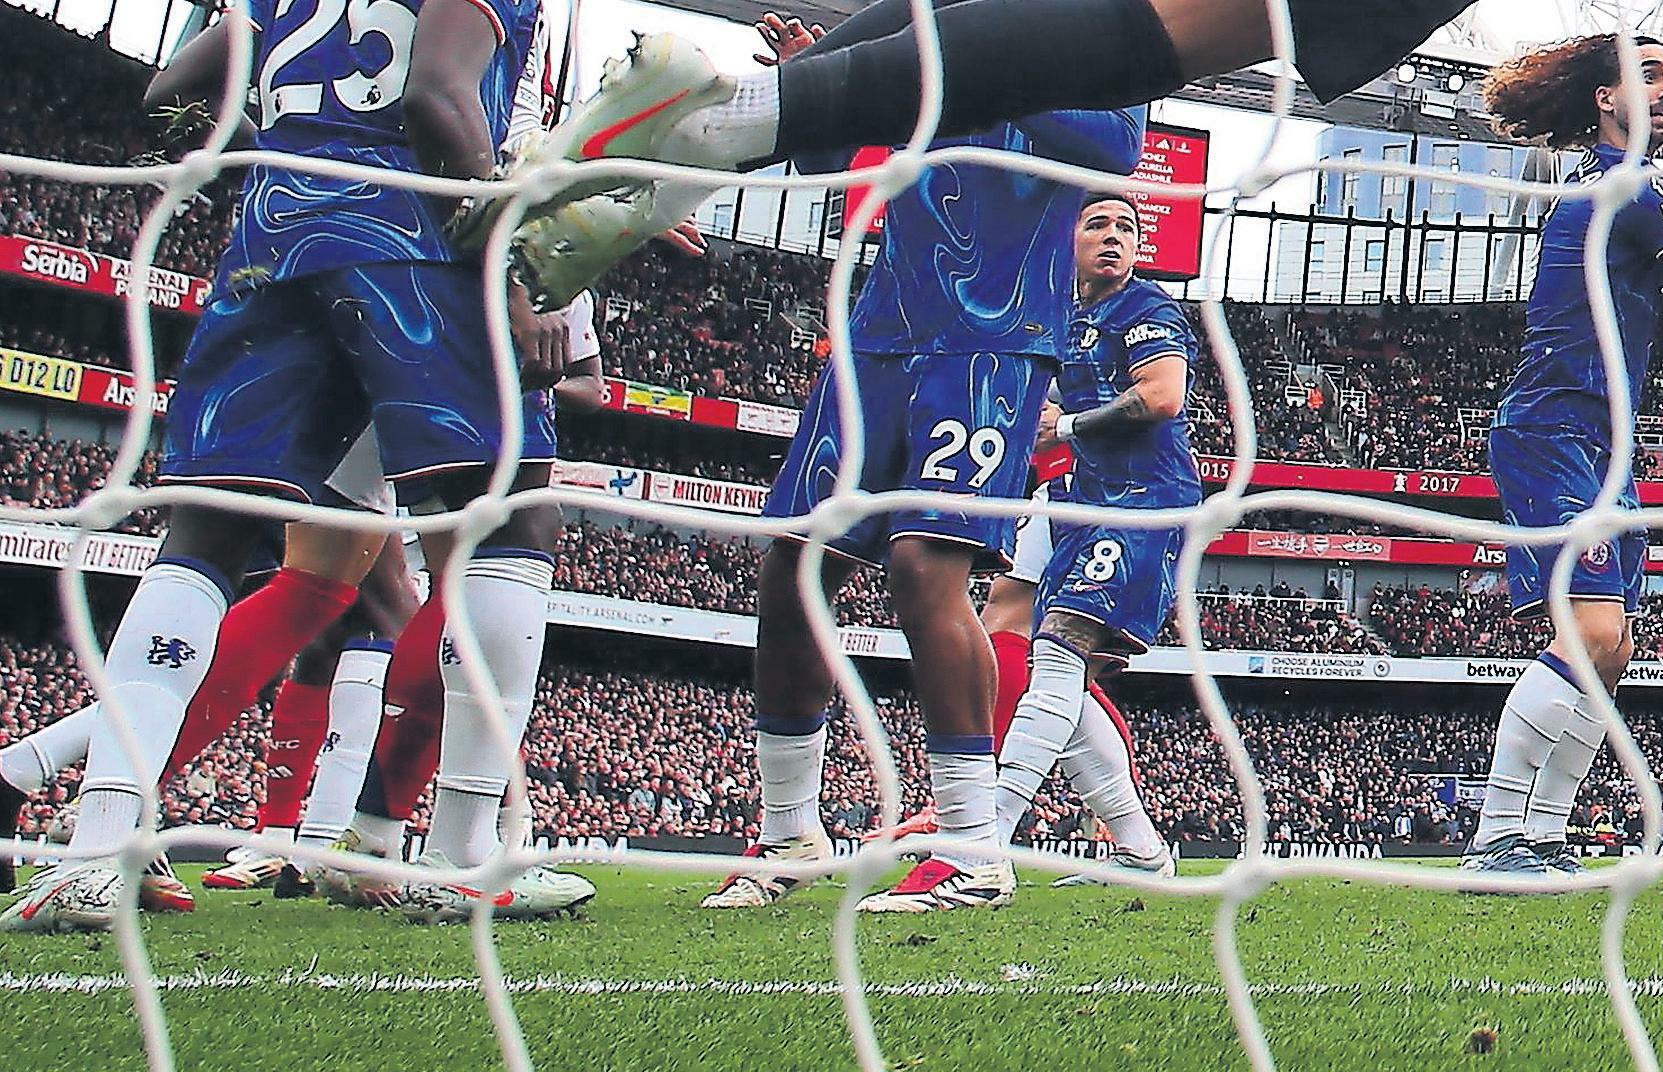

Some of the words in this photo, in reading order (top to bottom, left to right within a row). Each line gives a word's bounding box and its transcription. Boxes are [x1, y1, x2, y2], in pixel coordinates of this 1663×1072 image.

[21, 243, 88, 284] Serbia
[115, 262, 189, 292] AENAL
[115, 280, 181, 309] PAND
[103, 377, 175, 413] Arsna
[920, 419, 1006, 489] 29
[1200, 461, 1230, 478] 015
[1418, 475, 1460, 493] 2017
[672, 479, 722, 504] MILTON
[0, 532, 73, 562] mirates
[1084, 539, 1121, 582] 8
[844, 632, 879, 653] BETTER
[1467, 662, 1526, 681] betway
[1289, 842, 1384, 859] RWANDA
